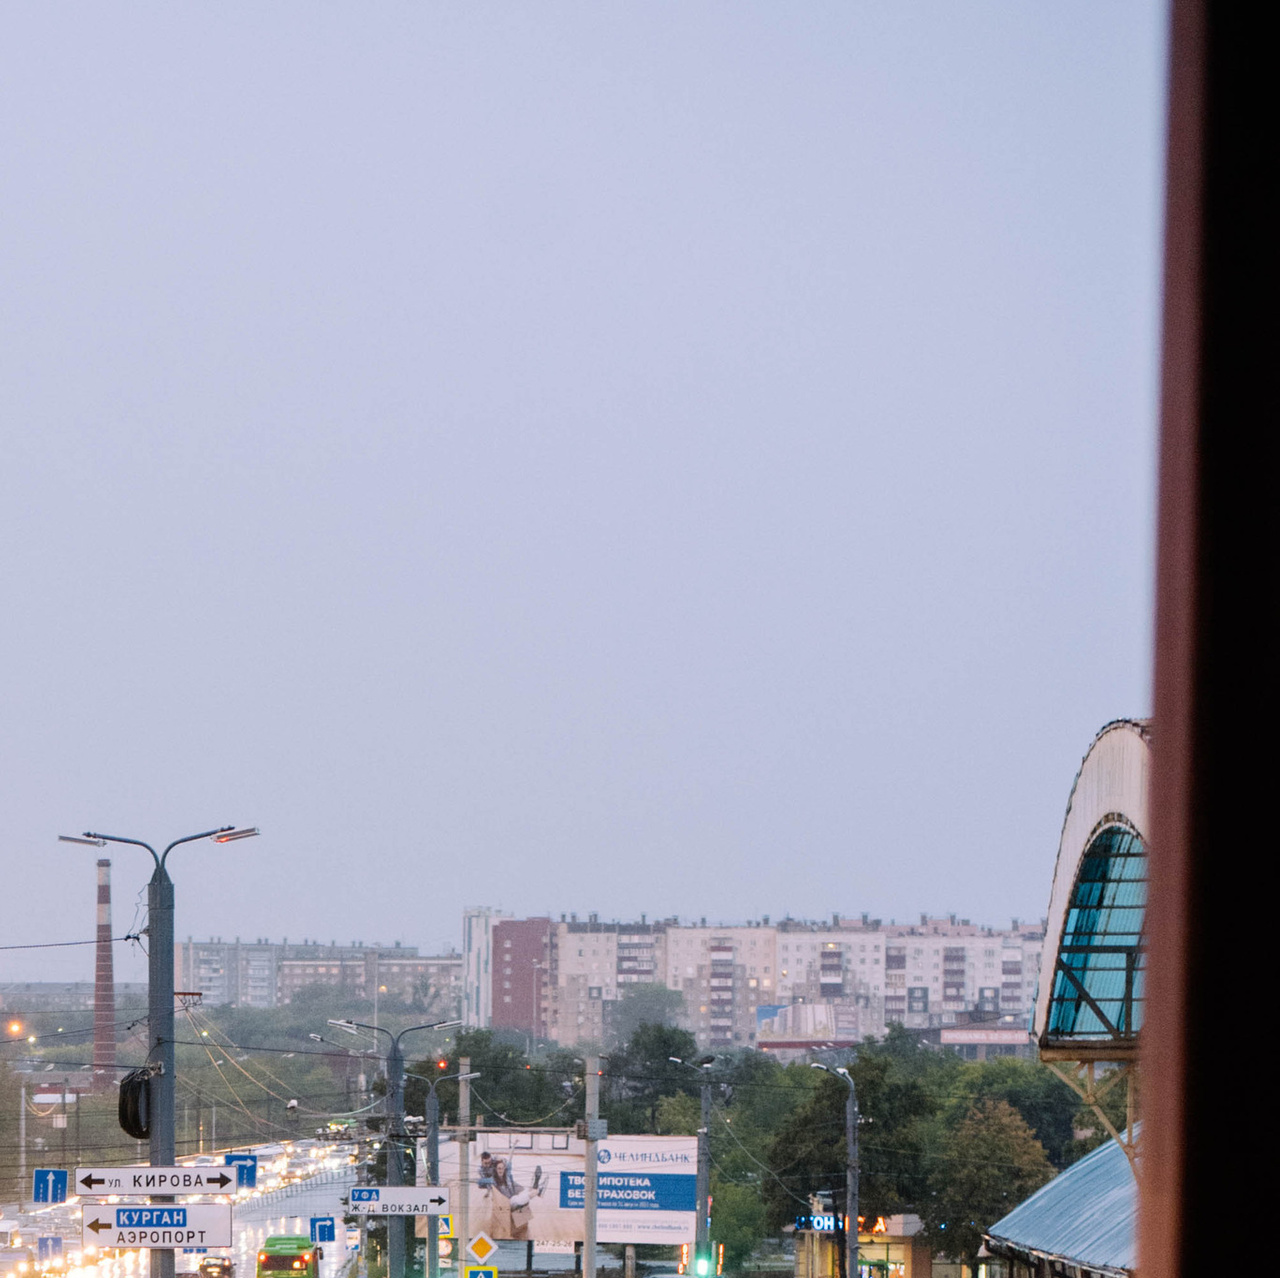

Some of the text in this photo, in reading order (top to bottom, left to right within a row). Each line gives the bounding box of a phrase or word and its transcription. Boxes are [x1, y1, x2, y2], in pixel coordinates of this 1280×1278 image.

[614, 1152, 691, 1163] ЧЕЛИНДБАНК
[132, 1174, 204, 1188] КИРОВА
[599, 1177, 651, 1187] ИПОТЕКА
[353, 1191, 379, 1200] УФА
[597, 1190, 656, 1200] ТРАХОВОК
[381, 1204, 429, 1213] ВОКЗАЛ
[119, 1211, 184, 1225] КУРГАН
[117, 1231, 207, 1244] АЭРОПОРТ
